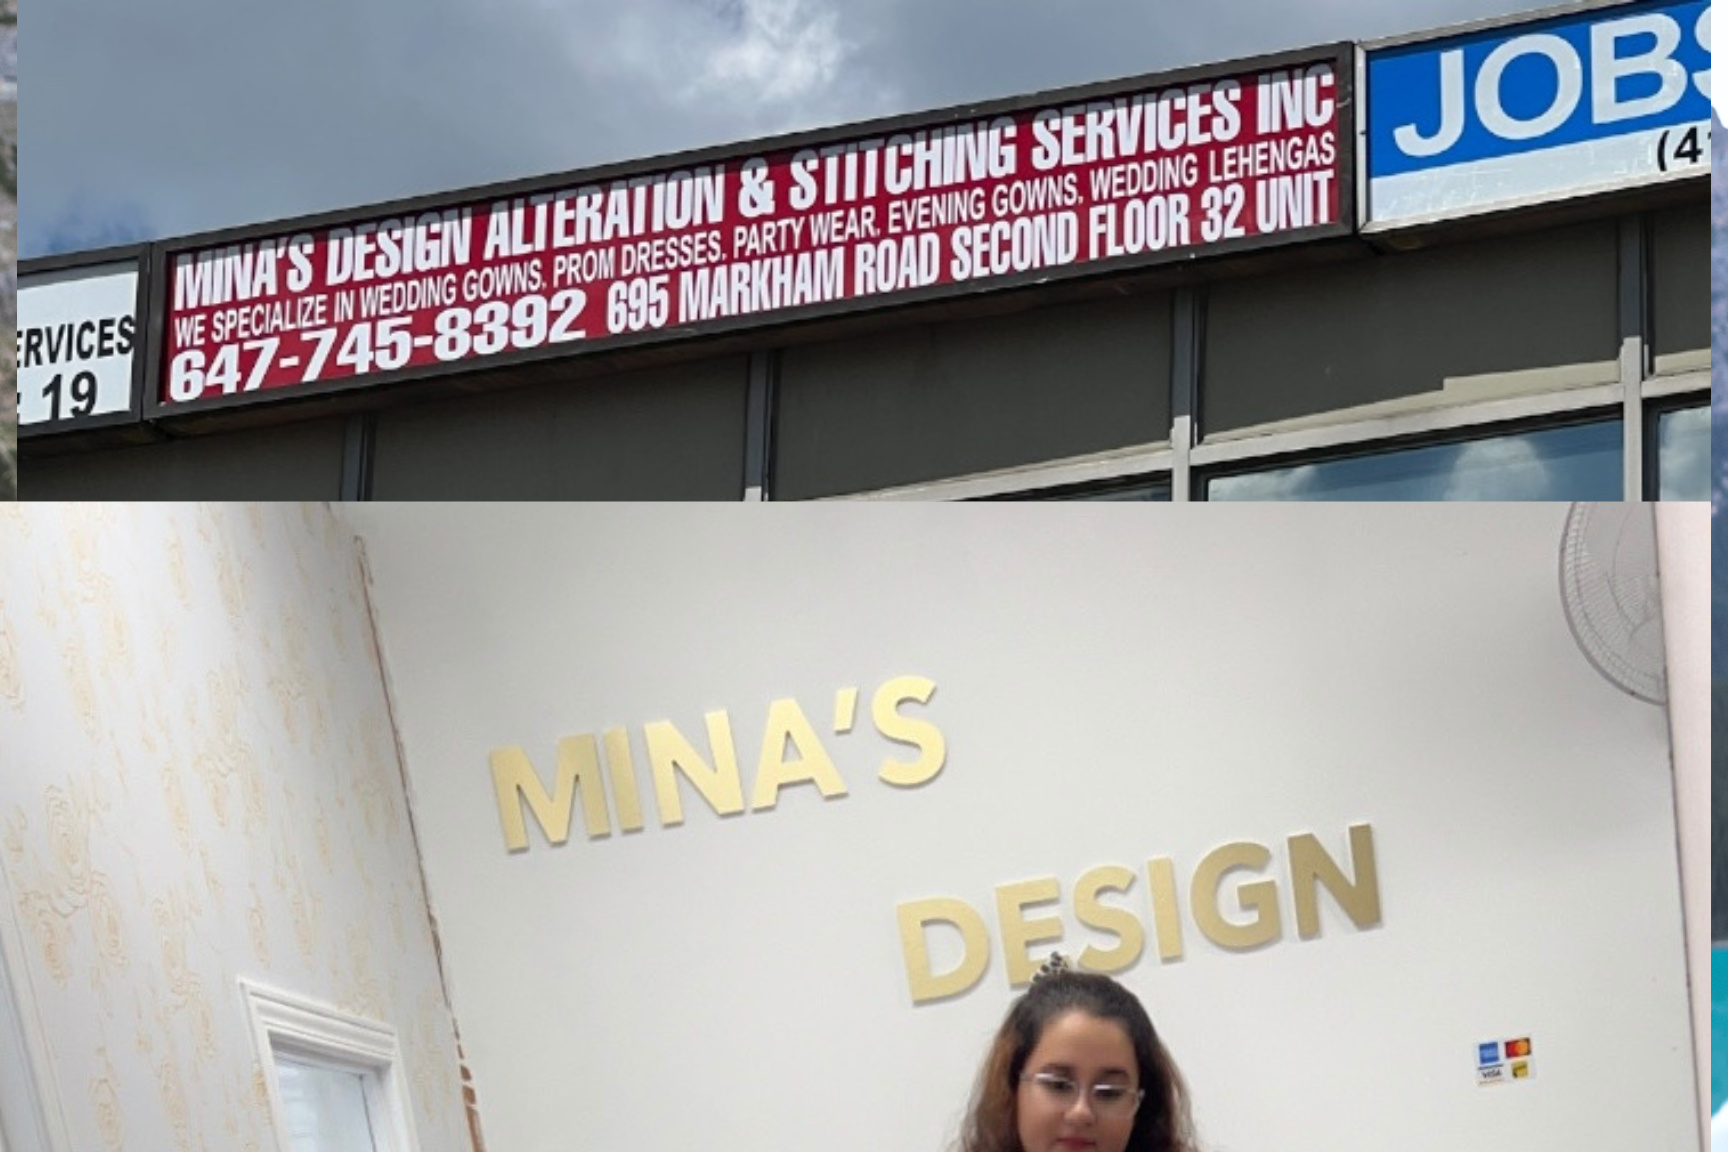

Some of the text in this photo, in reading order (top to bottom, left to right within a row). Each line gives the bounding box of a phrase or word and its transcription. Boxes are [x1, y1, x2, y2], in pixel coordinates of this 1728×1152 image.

[1393, 5, 1711, 157] JOB
[1657, 126, 1711, 172] (4
[174, 64, 1334, 311] MINA'S DESIGN ALTERATION & STITCHING SERVICES INC
[175, 314, 206, 348] WE
[211, 294, 327, 342] SPECIALIZE
[334, 289, 354, 322] IN
[360, 273, 456, 318] WEDDING
[553, 246, 614, 287] PROM
[734, 217, 804, 257] PARTY
[888, 187, 985, 234] EVENING
[1090, 153, 1197, 200] WEDDING
[1209, 131, 1335, 183] LEHENGAS
[169, 169, 1334, 402] 647-745-8392 695 MARKHAM ROAD SECOND FLOOR 32 UNIT
[488, 675, 947, 852] MINA'S
[895, 823, 1383, 1006] DESIGN
